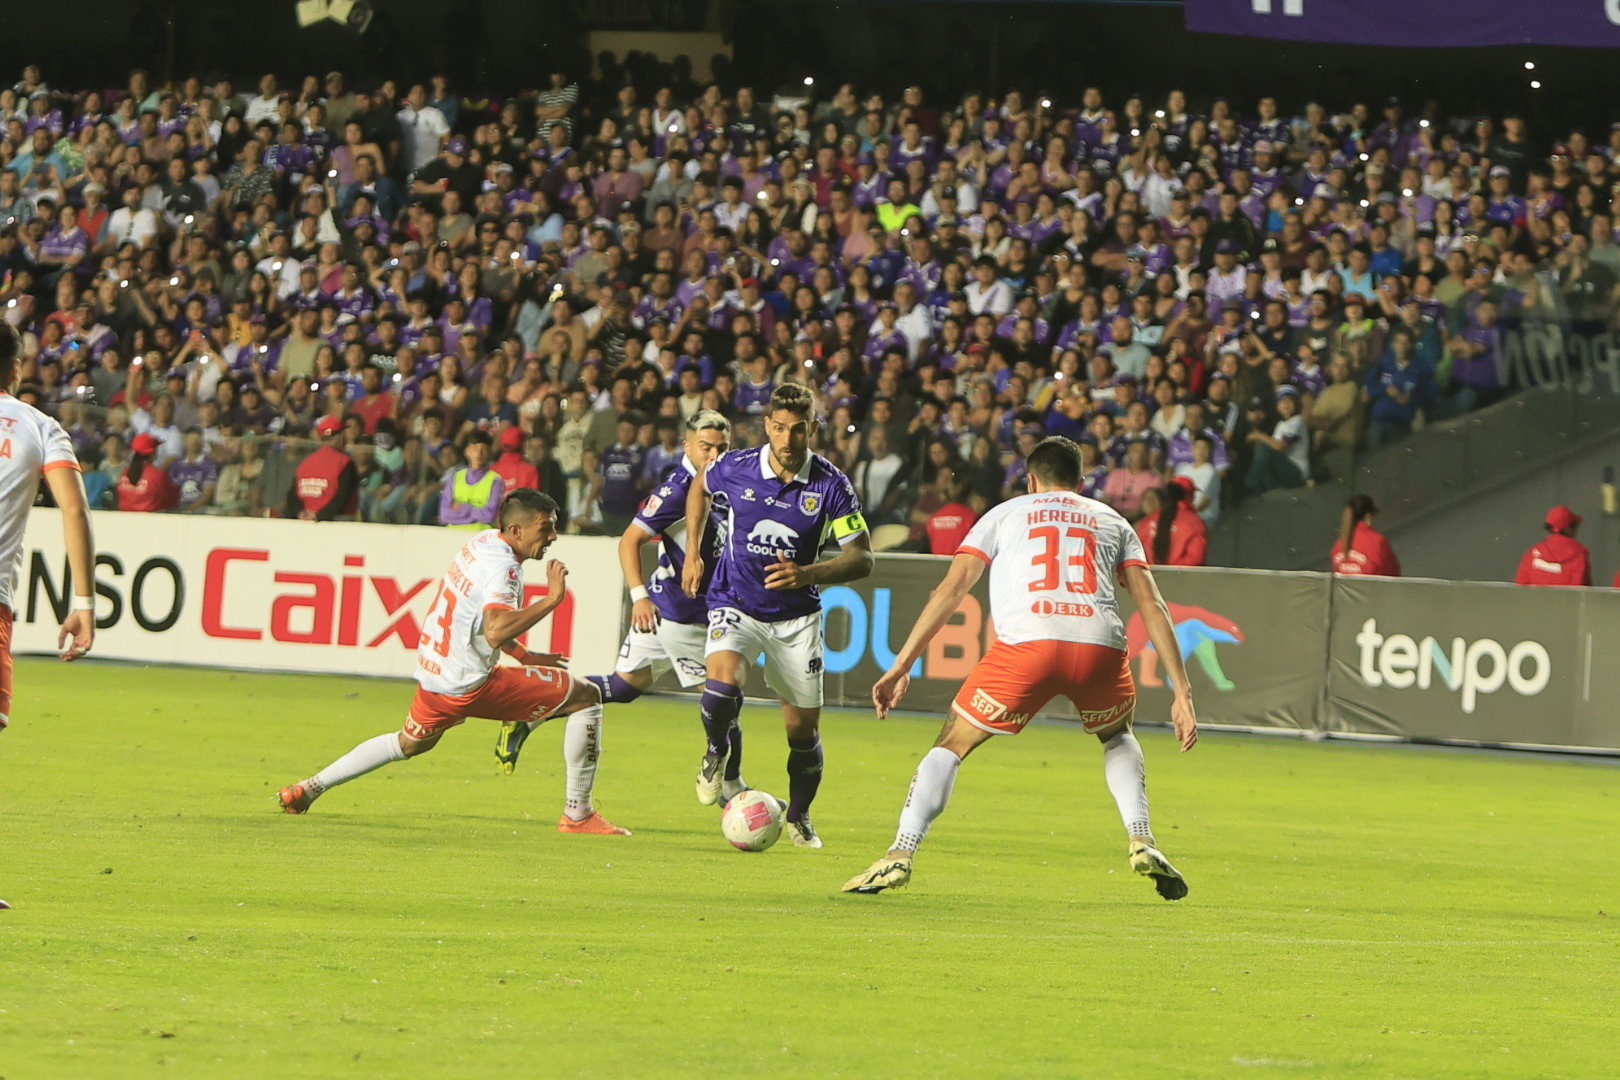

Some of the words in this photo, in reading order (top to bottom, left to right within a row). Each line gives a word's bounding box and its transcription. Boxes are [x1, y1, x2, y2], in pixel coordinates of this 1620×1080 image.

[846, 515, 861, 531] C
[1027, 509, 1099, 530] HEREDIA
[746, 543, 798, 559] COOLET
[1028, 525, 1099, 595] 33
[12, 547, 186, 633] NSO
[201, 546, 576, 661] Caixn
